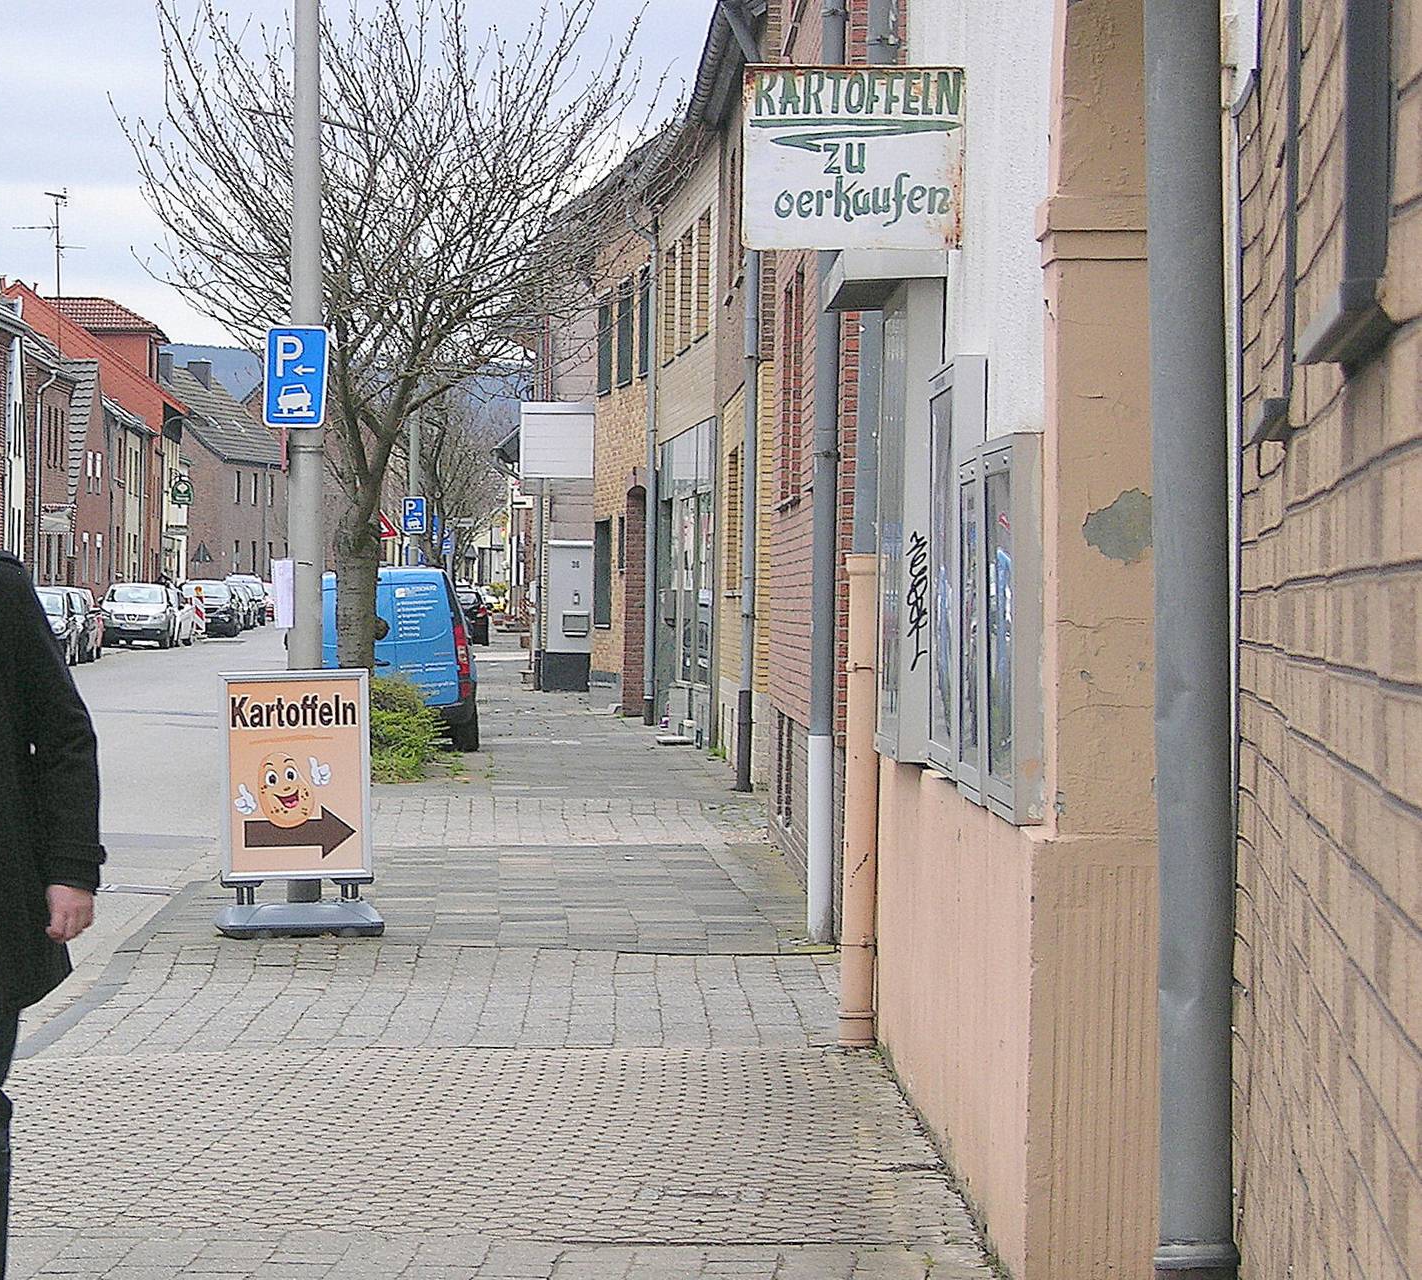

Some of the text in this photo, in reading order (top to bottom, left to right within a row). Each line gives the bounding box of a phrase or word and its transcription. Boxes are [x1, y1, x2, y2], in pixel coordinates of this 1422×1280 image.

[754, 70, 964, 116] KARTOFFELN
[275, 335, 304, 378] P
[406, 500, 416, 516] P
[230, 694, 357, 728] Kartoffeln
